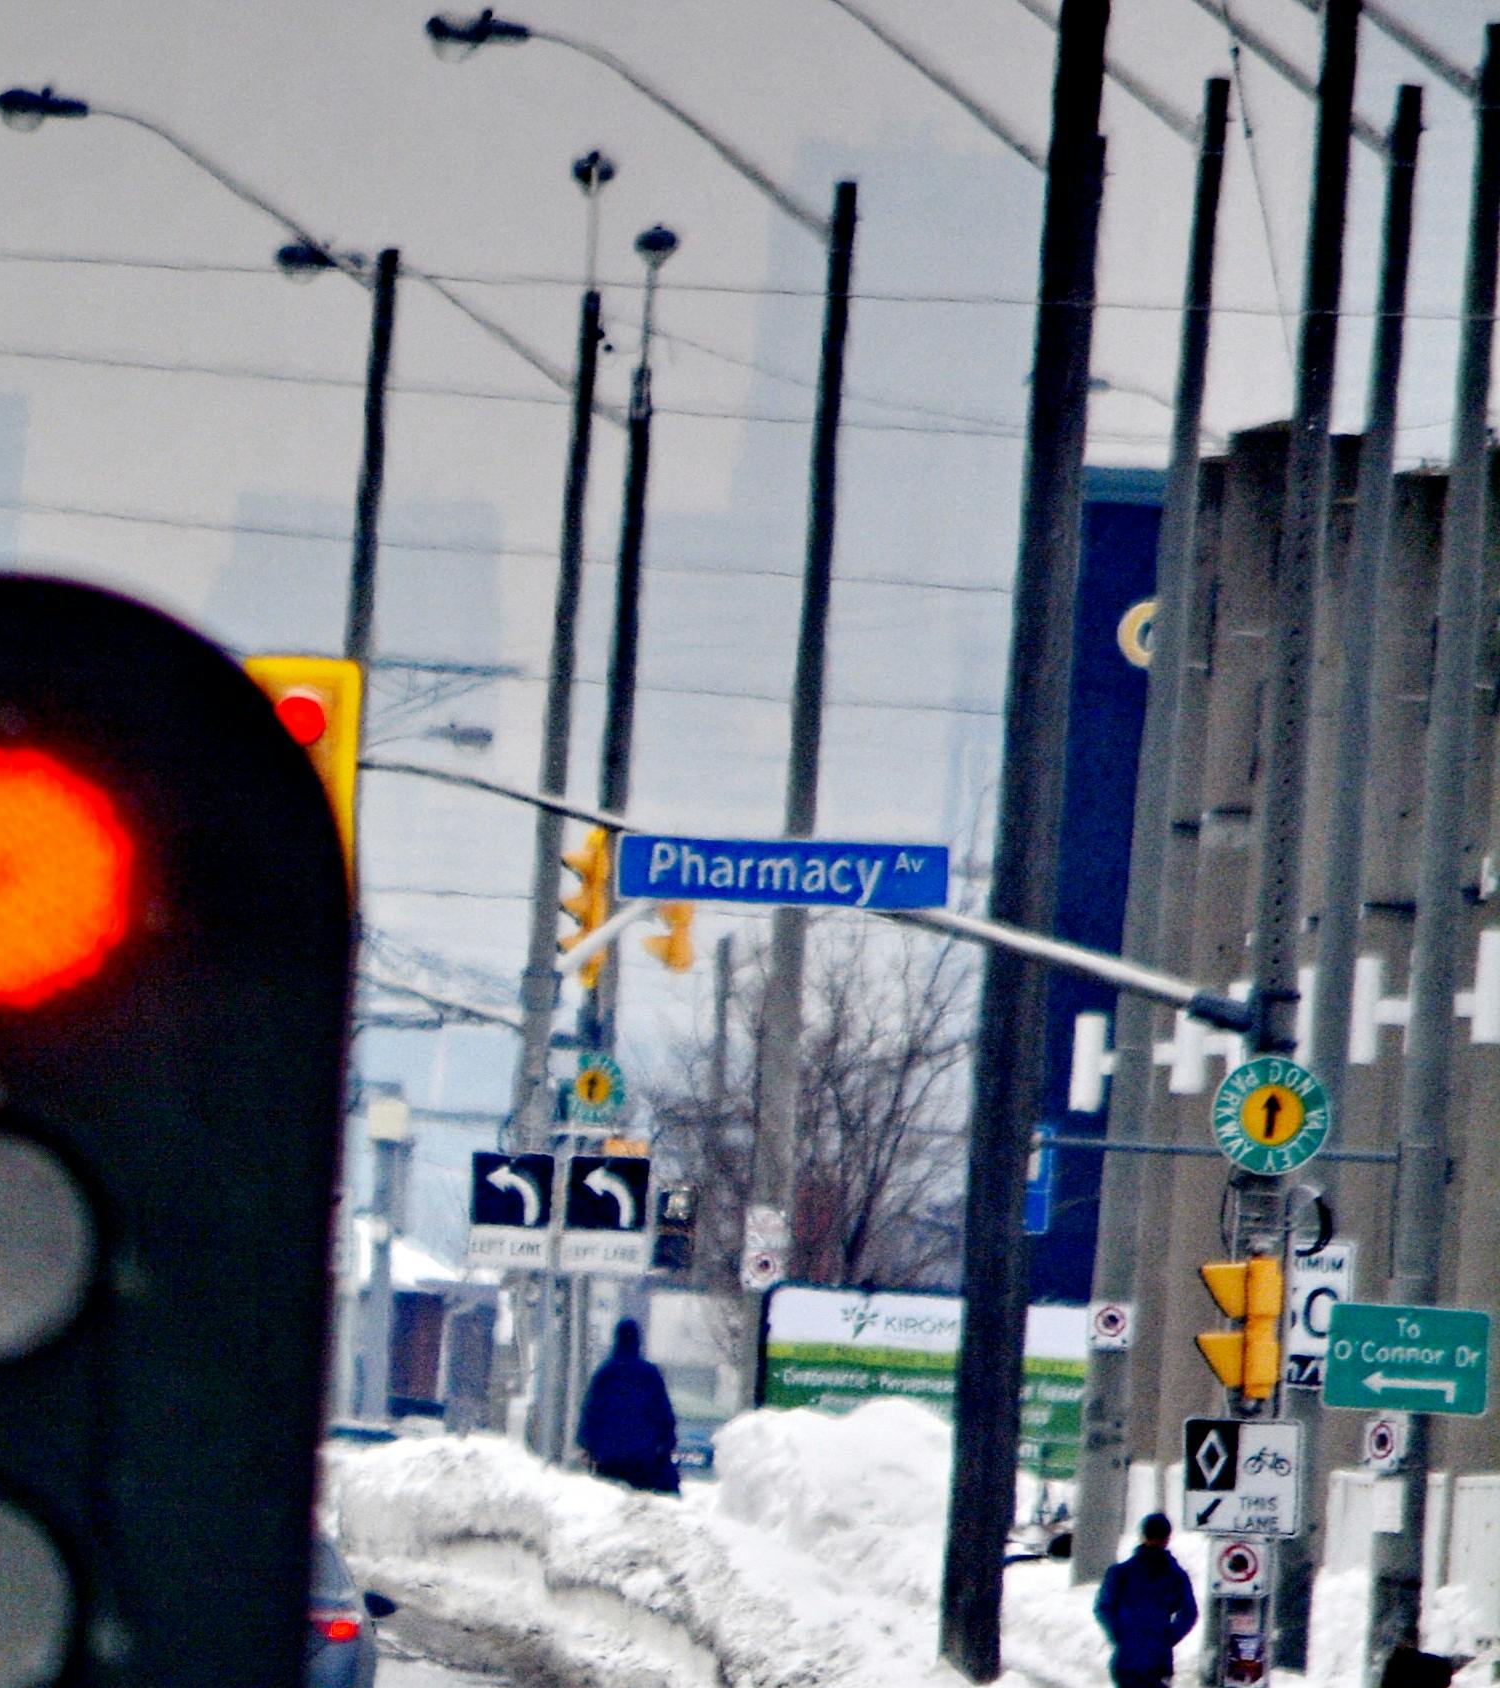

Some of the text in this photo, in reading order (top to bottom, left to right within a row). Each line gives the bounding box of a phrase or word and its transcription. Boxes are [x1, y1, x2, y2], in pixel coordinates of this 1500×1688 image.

[649, 842, 925, 906] Pharmacy Av
[1395, 1315, 1422, 1339] To
[1333, 1338, 1482, 1369] O'Connor Dr
[1239, 1496, 1279, 1513] THIS
[1233, 1515, 1281, 1534] LANE
